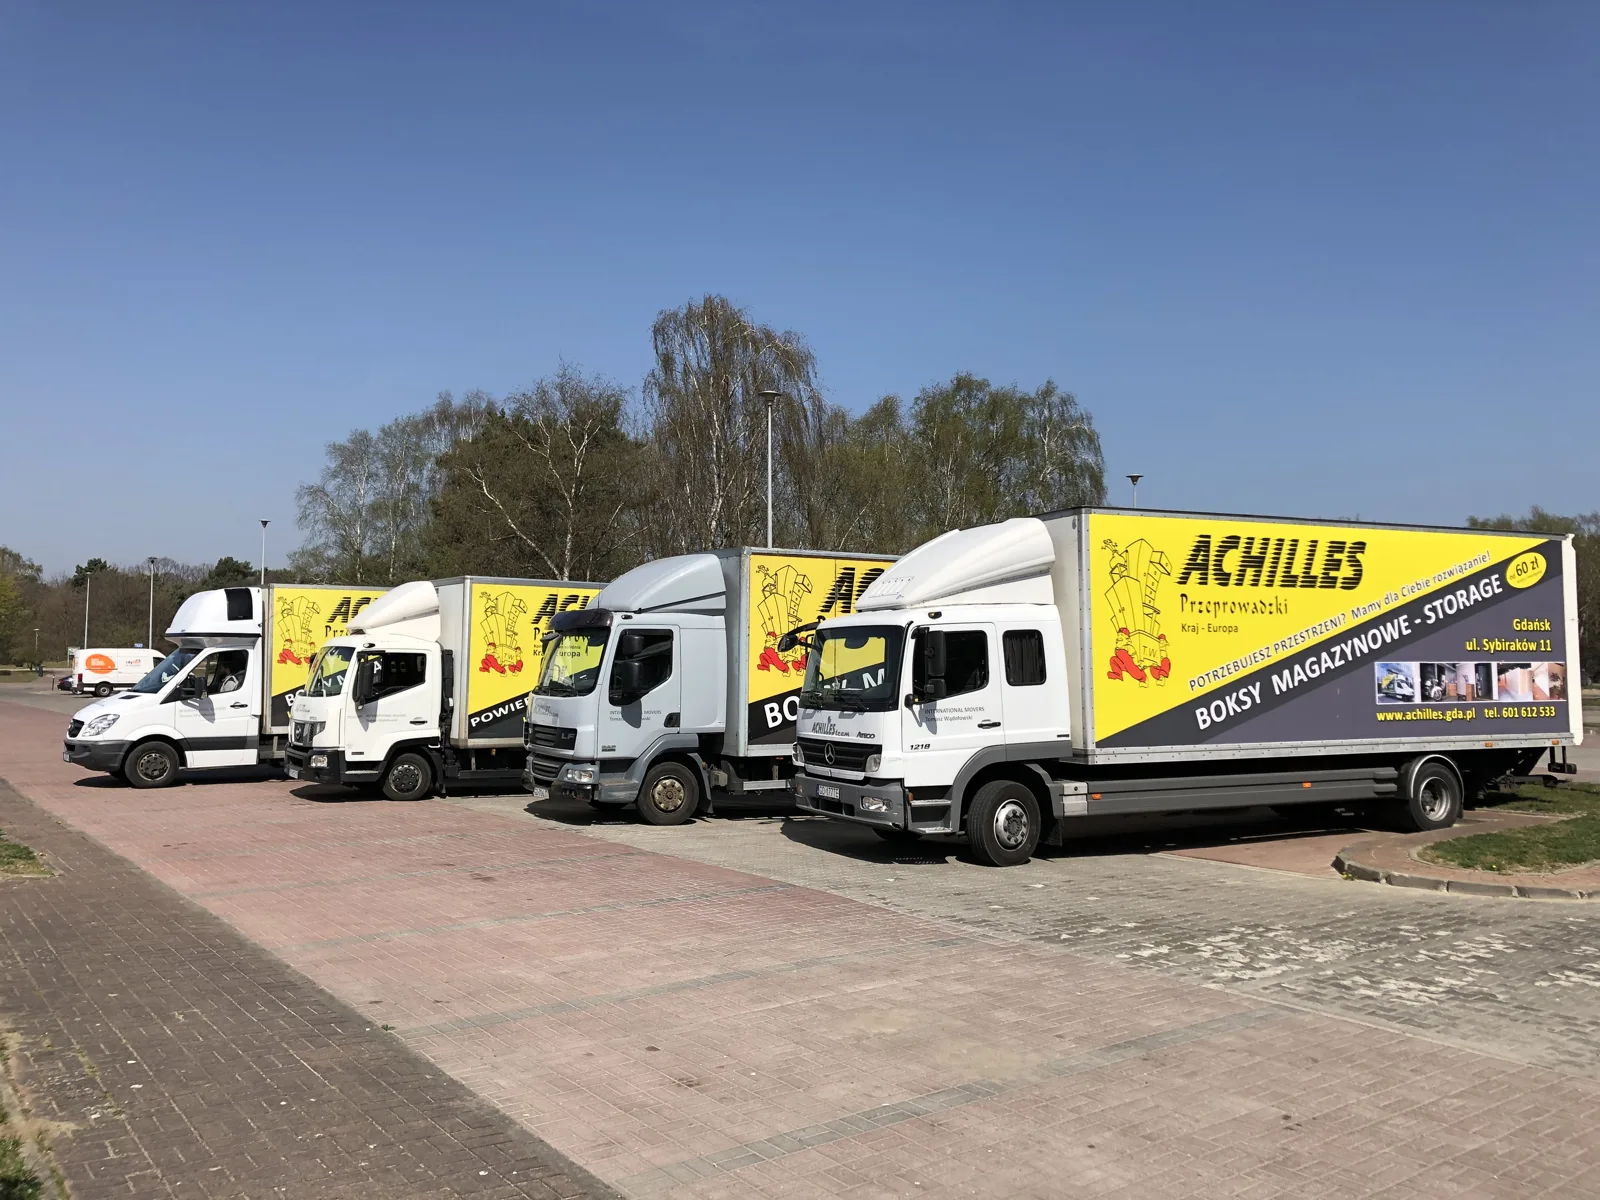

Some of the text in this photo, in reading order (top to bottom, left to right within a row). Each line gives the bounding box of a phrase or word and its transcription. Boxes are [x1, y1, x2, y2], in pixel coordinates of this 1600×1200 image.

[1174, 534, 1367, 590] ACHILLES
[1515, 561, 1529, 577] 60
[1530, 555, 1540, 571] zł
[1180, 593, 1288, 618] Przeprowadzki
[1181, 623, 1199, 634] Kraj
[1207, 623, 1239, 634] Europa
[1188, 646, 1273, 691] POTRZEBUJESZ
[1273, 613, 1347, 655] PRZESTRZENI?
[1351, 600, 1382, 620] Mamy
[1383, 592, 1400, 607] dla
[1400, 577, 1431, 598] Ciebie
[1432, 550, 1492, 584] rozwiązanie!
[1513, 617, 1551, 631] Gdańsk
[1195, 681, 1262, 730] BOKSY
[1270, 614, 1412, 696] MAGAZYNOWE
[1423, 573, 1503, 625] STORAGE
[1465, 638, 1552, 653] ul. Sybiraków 11
[924, 707, 964, 715] INTERNATIONAL
[1376, 706, 1556, 722] www.achilles.gda.pl tel. 601 612 533
